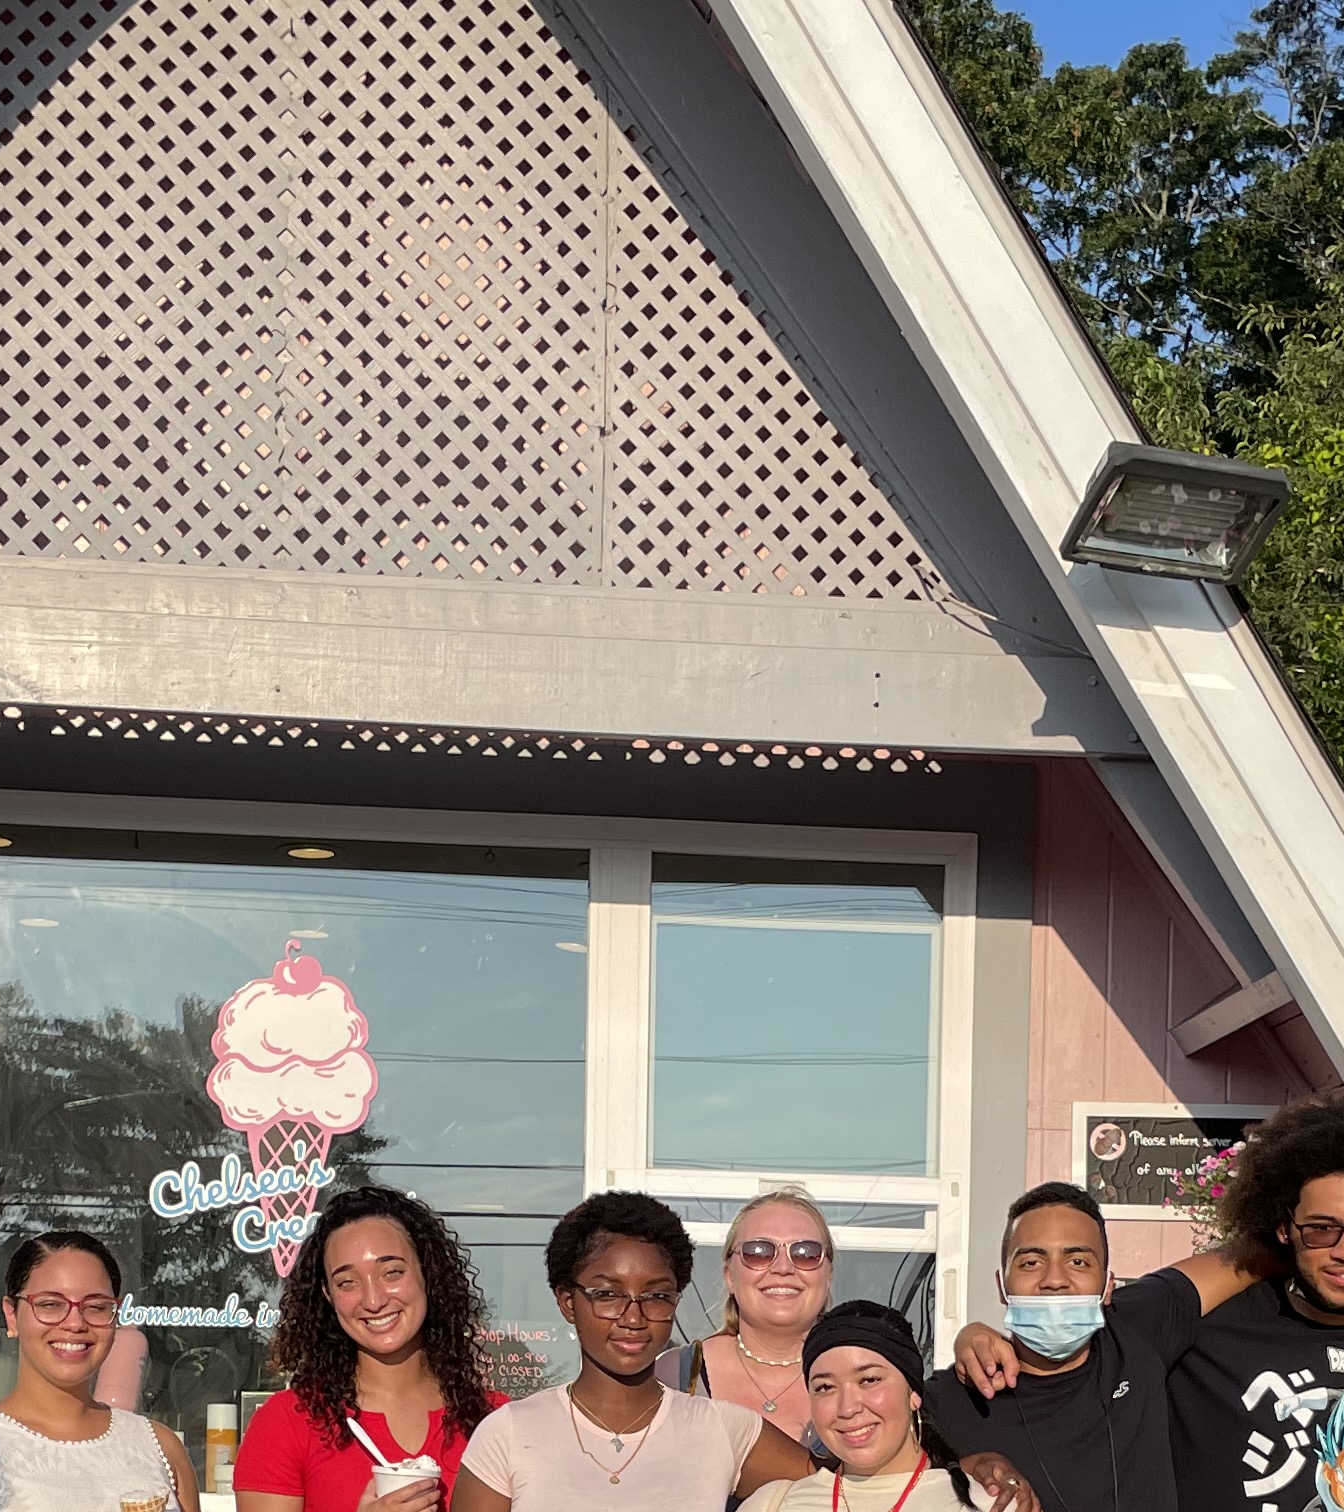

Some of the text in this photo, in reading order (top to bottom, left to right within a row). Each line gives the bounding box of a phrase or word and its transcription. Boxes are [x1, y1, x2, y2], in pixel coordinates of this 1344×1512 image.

[1129, 1130, 1166, 1147] Please
[1169, 1133, 1200, 1147] inform
[1136, 1163, 1150, 1175] of
[149, 1140, 335, 1217] Chelsea's
[499, 1364, 543, 1378] CLOSED
